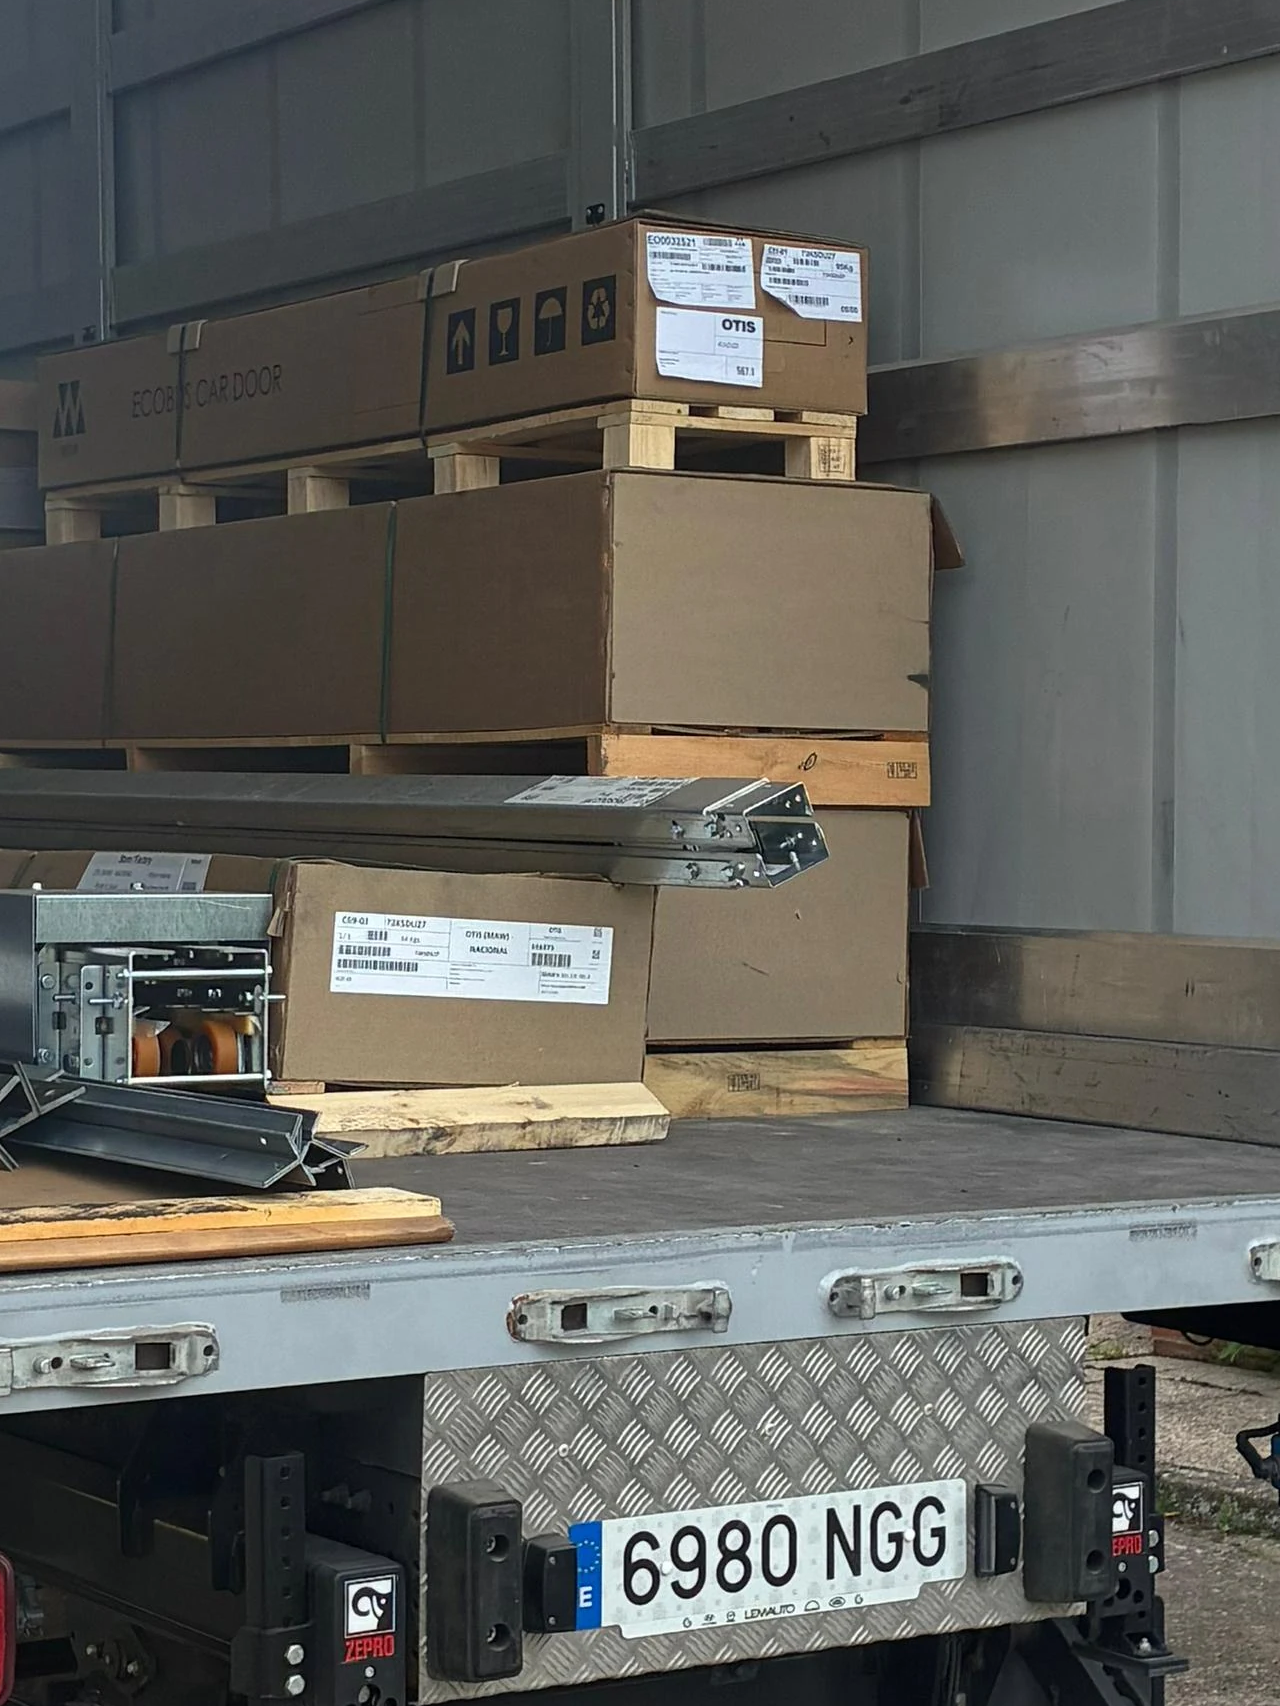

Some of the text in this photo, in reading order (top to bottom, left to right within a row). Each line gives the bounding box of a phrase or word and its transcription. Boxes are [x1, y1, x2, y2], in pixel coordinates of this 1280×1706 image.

[721, 318, 756, 334] OTIS
[131, 364, 283, 419] ECOBS CAR DOOR
[622, 1494, 948, 1608] 6980 NGG
[579, 1586, 593, 1608] E
[344, 1635, 395, 1663] ZEPRO
